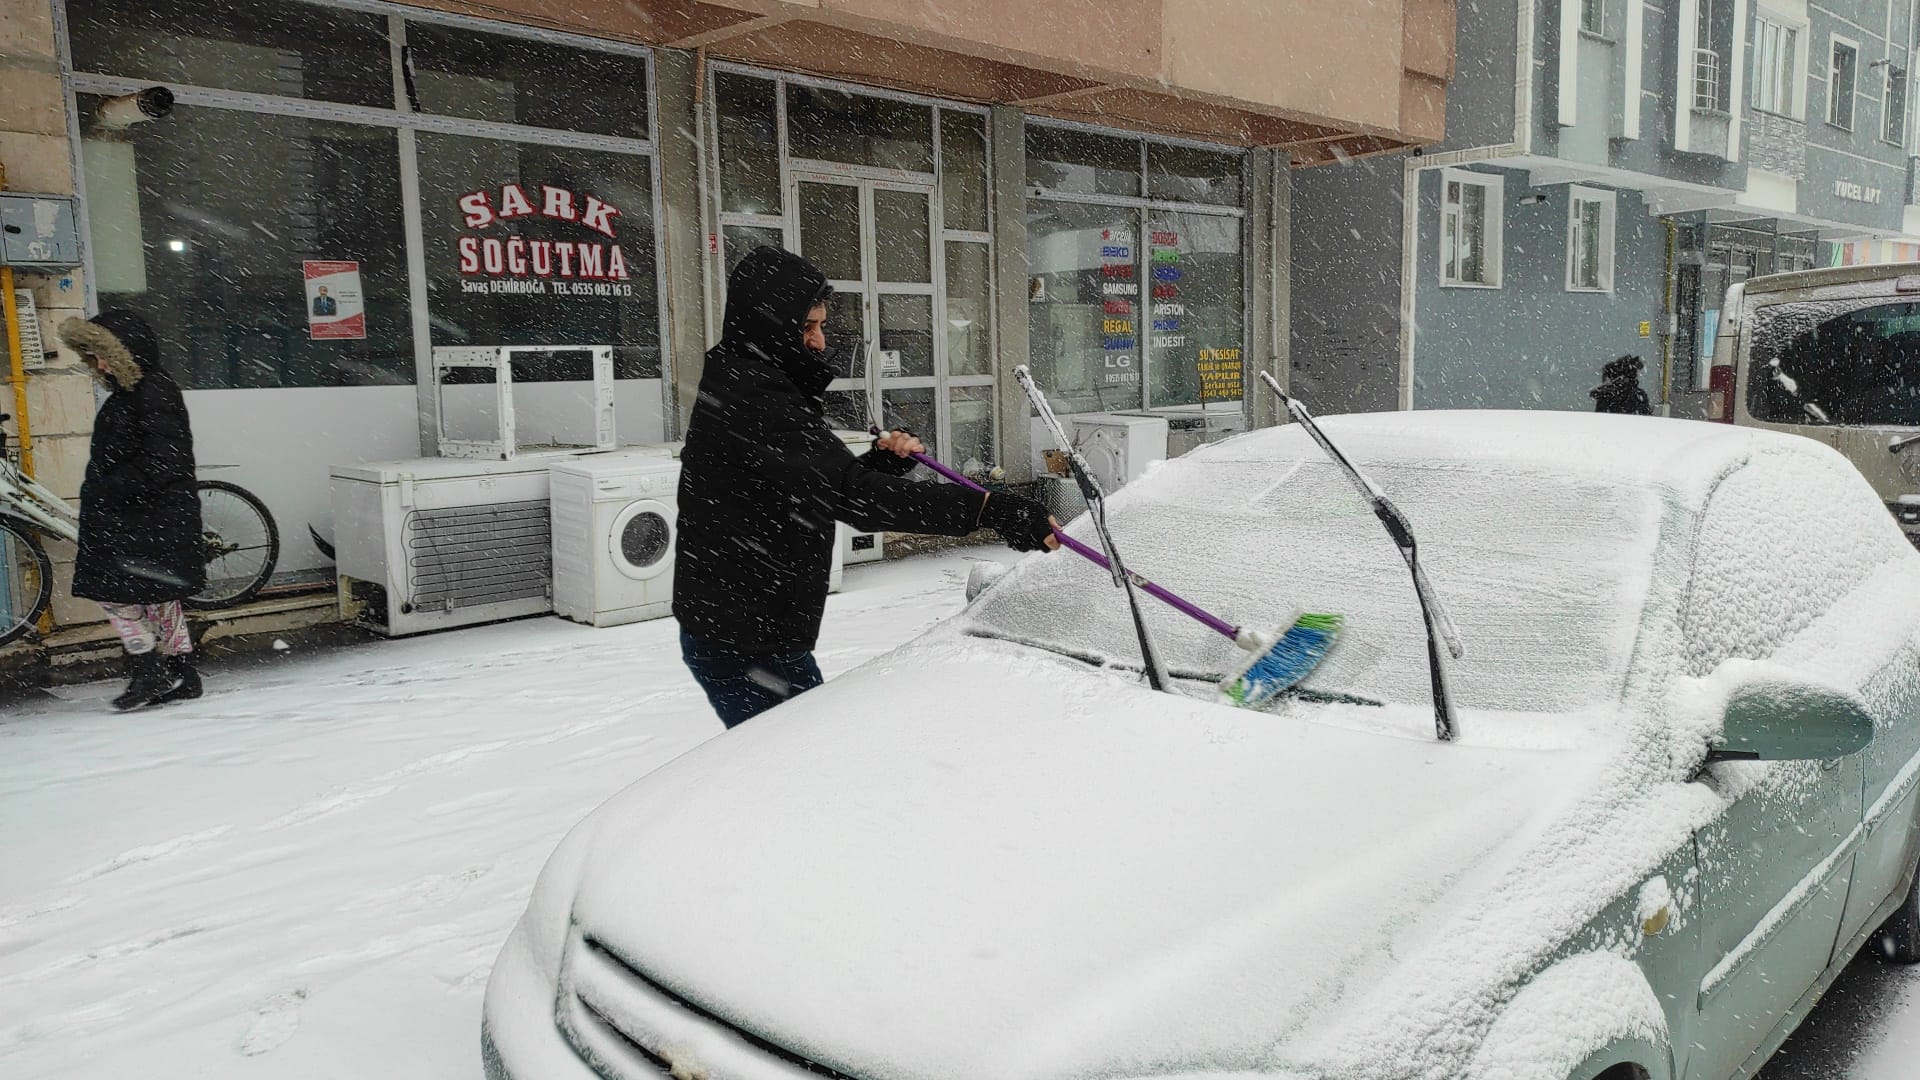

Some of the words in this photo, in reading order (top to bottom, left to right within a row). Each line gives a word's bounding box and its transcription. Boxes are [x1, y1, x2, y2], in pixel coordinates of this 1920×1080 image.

[459, 235, 630, 280] SOĞUTMA
[1102, 246, 1129, 258] BEKO
[461, 278, 489, 295] Savaş
[490, 277, 546, 295] DEMİRBOĞA
[571, 282, 594, 296] 0535
[594, 283, 612, 297] 082
[612, 284, 622, 297] 16
[622, 284, 632, 298] 13
[1102, 282, 1138, 295] SAMSUNG
[1153, 303, 1184, 316] ARISTON
[1103, 319, 1133, 334] REGAL
[1153, 336, 1186, 348] INDESIT
[1105, 355, 1131, 368] LG
[1199, 349, 1209, 361] SU
